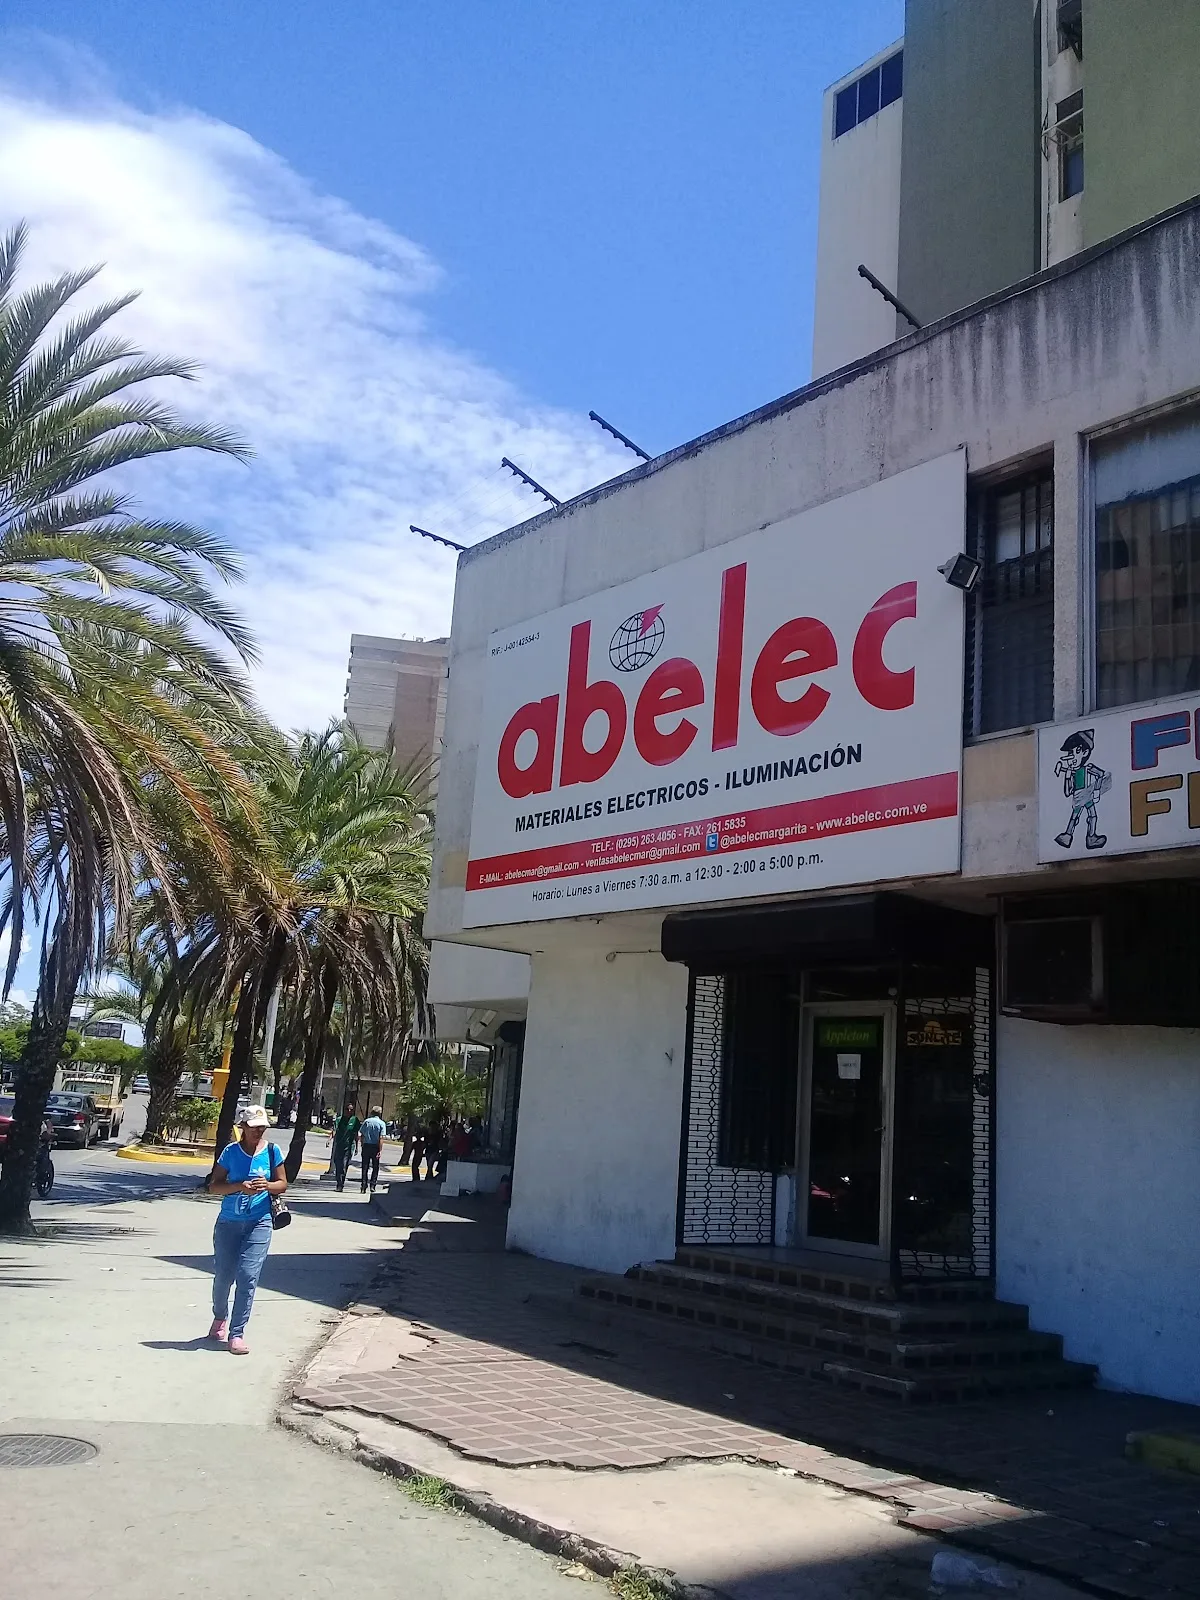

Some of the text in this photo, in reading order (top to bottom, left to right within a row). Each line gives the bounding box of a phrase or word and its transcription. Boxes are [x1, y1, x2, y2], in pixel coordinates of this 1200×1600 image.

[497, 562, 917, 798] abelec
[1131, 708, 1200, 770] F
[515, 800, 602, 833] MATERIALES
[607, 777, 709, 815] ELECTRICOS
[725, 743, 862, 791] ILUMINACIÓN
[1130, 772, 1200, 836] F
[479, 872, 504, 884] E-MAIL:
[504, 861, 579, 880] abelecmar@gmail.com
[585, 843, 700, 867] ventasabelecmar@gmail.com
[720, 823, 807, 849] @abelecmargarita
[816, 801, 928, 832] www.abelec.com.ve
[615, 836, 639, 852] (0295)
[640, 829, 677, 846] 263.4056
[683, 825, 704, 838] FAX:
[706, 816, 746, 834] 261.5835
[532, 888, 564, 902] Horario:
[566, 885, 593, 898] Lunes
[594, 885, 600, 893] a
[602, 878, 637, 893] Viernes
[639, 874, 659, 888] 7:30
[661, 872, 682, 885] a.m.
[685, 871, 691, 882] a
[694, 864, 723, 881] 12:30
[732, 859, 756, 875] 2:00
[759, 861, 766, 871] a
[769, 854, 794, 870] 5:00
[797, 853, 824, 869] p.m.
